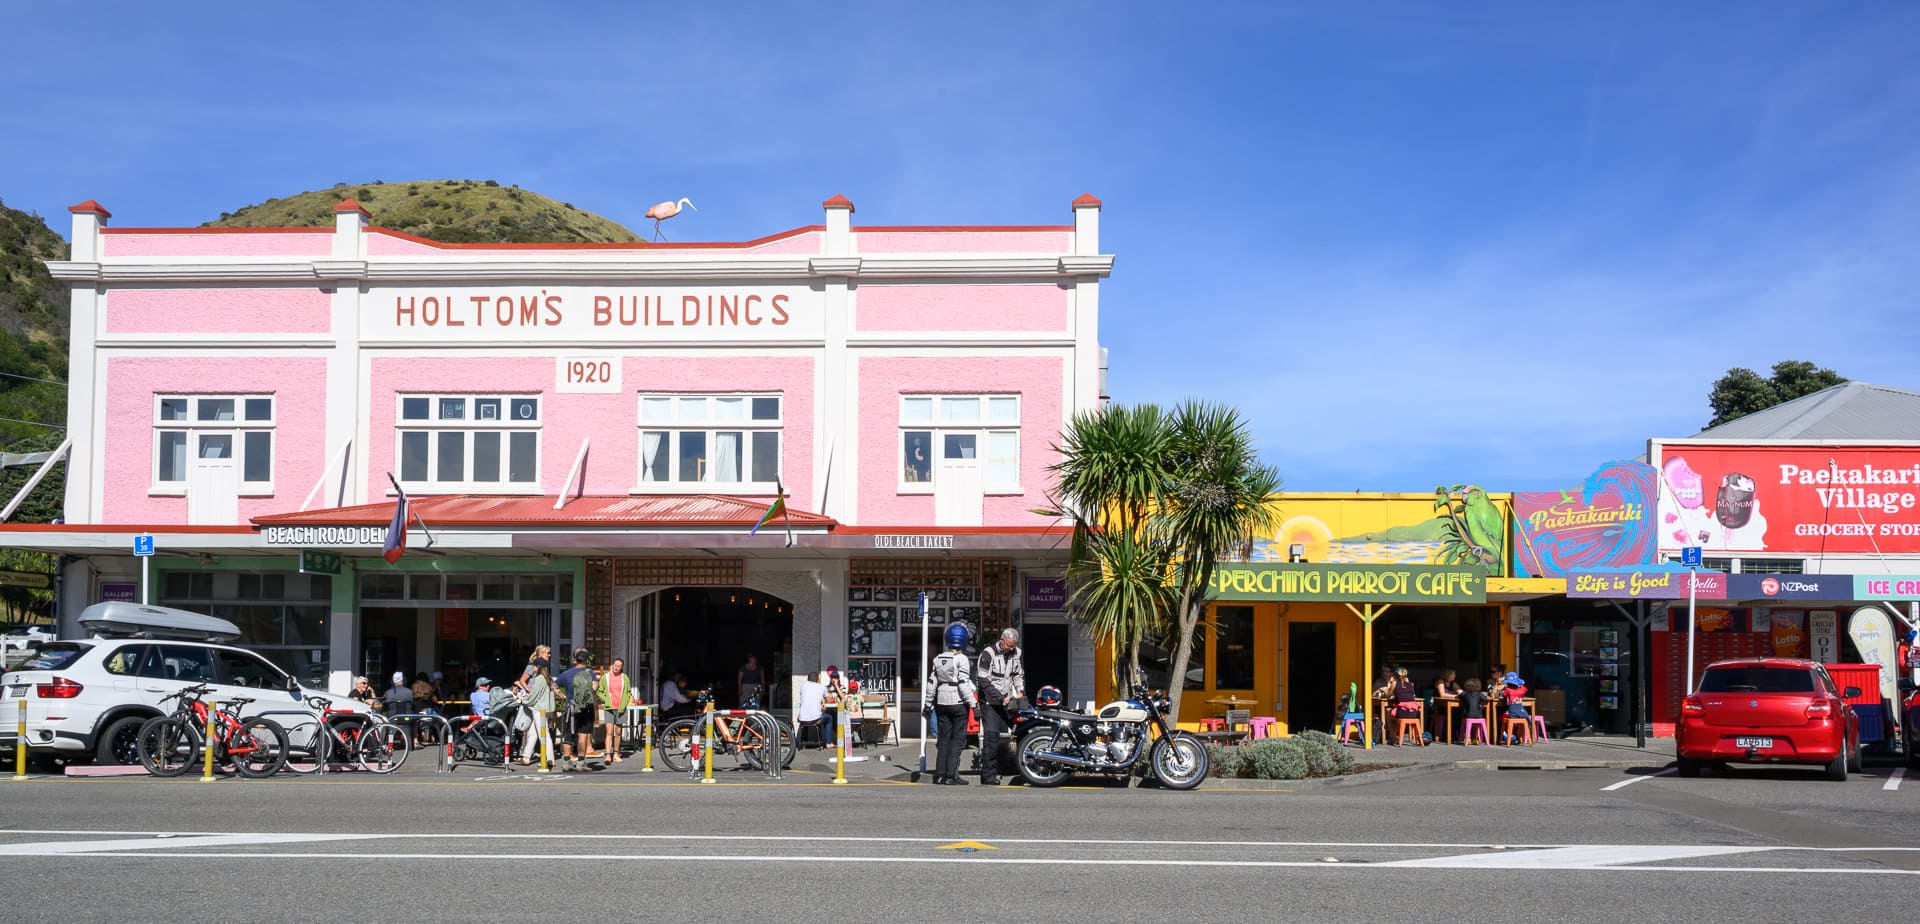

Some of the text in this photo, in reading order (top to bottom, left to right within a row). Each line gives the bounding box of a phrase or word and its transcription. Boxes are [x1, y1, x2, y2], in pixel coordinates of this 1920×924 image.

[397, 290, 563, 326] HOLTOM'S
[567, 361, 611, 384] 1920
[1816, 488, 1915, 513] Village
[1529, 503, 1643, 531] Paekakariki
[268, 527, 314, 543] BEACH
[318, 527, 356, 543] ROAD
[1795, 523, 1920, 536] GROCERY STO
[140, 537, 147, 545] P
[875, 536, 953, 547] OLDE BEACH BAKERY
[1688, 548, 1695, 556] P
[1219, 569, 1320, 594] PERCHING
[1328, 571, 1410, 595] PARROT
[1416, 572, 1473, 596] CAFE
[1575, 572, 1670, 596] Life is Good
[1781, 582, 1819, 592] NZPost
[1868, 581, 1890, 594] ICE
[1776, 635, 1800, 645] Lotto
[867, 661, 894, 678] OLDE
[868, 679, 894, 691] BEACH
